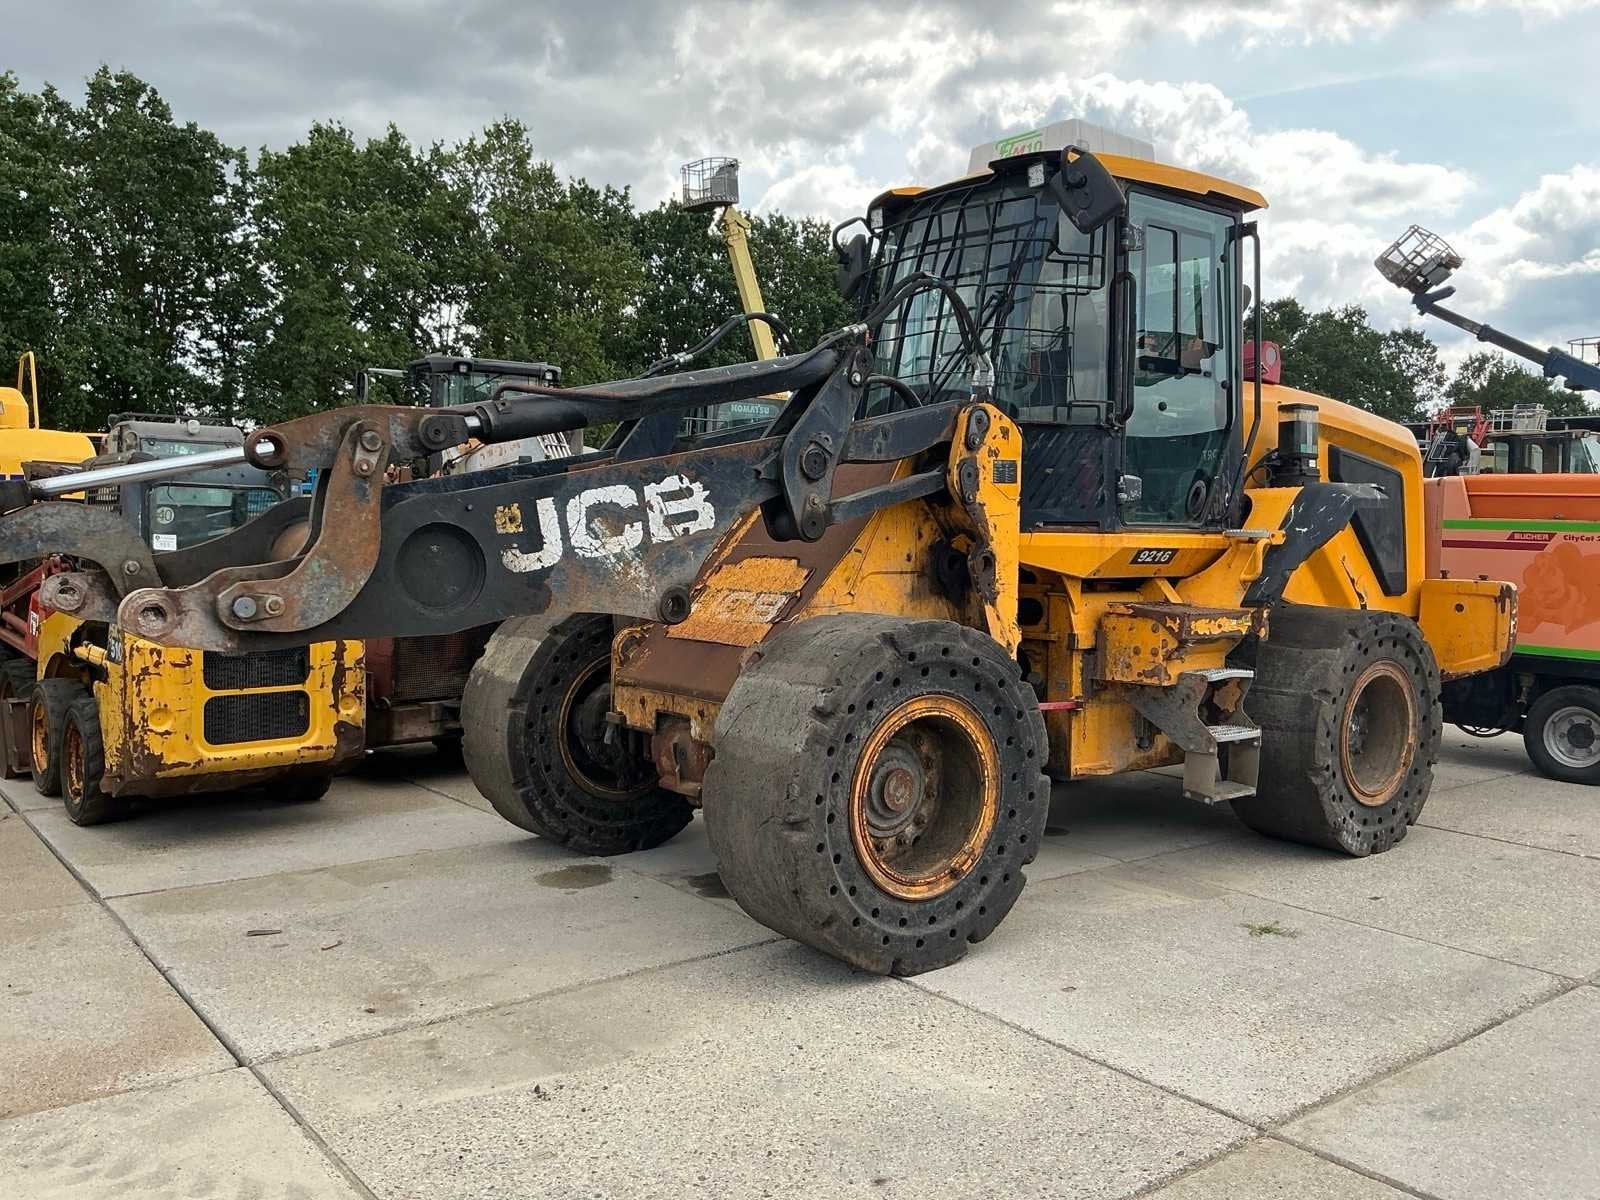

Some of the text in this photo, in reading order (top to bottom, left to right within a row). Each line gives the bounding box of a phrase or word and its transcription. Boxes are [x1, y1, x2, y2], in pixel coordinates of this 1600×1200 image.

[731, 403, 770, 415] KOMATSU
[500, 473, 715, 573] JCB
[1514, 532, 1549, 542] BUCHER
[1563, 534, 1595, 543] CityCat
[1137, 550, 1172, 562] 9216
